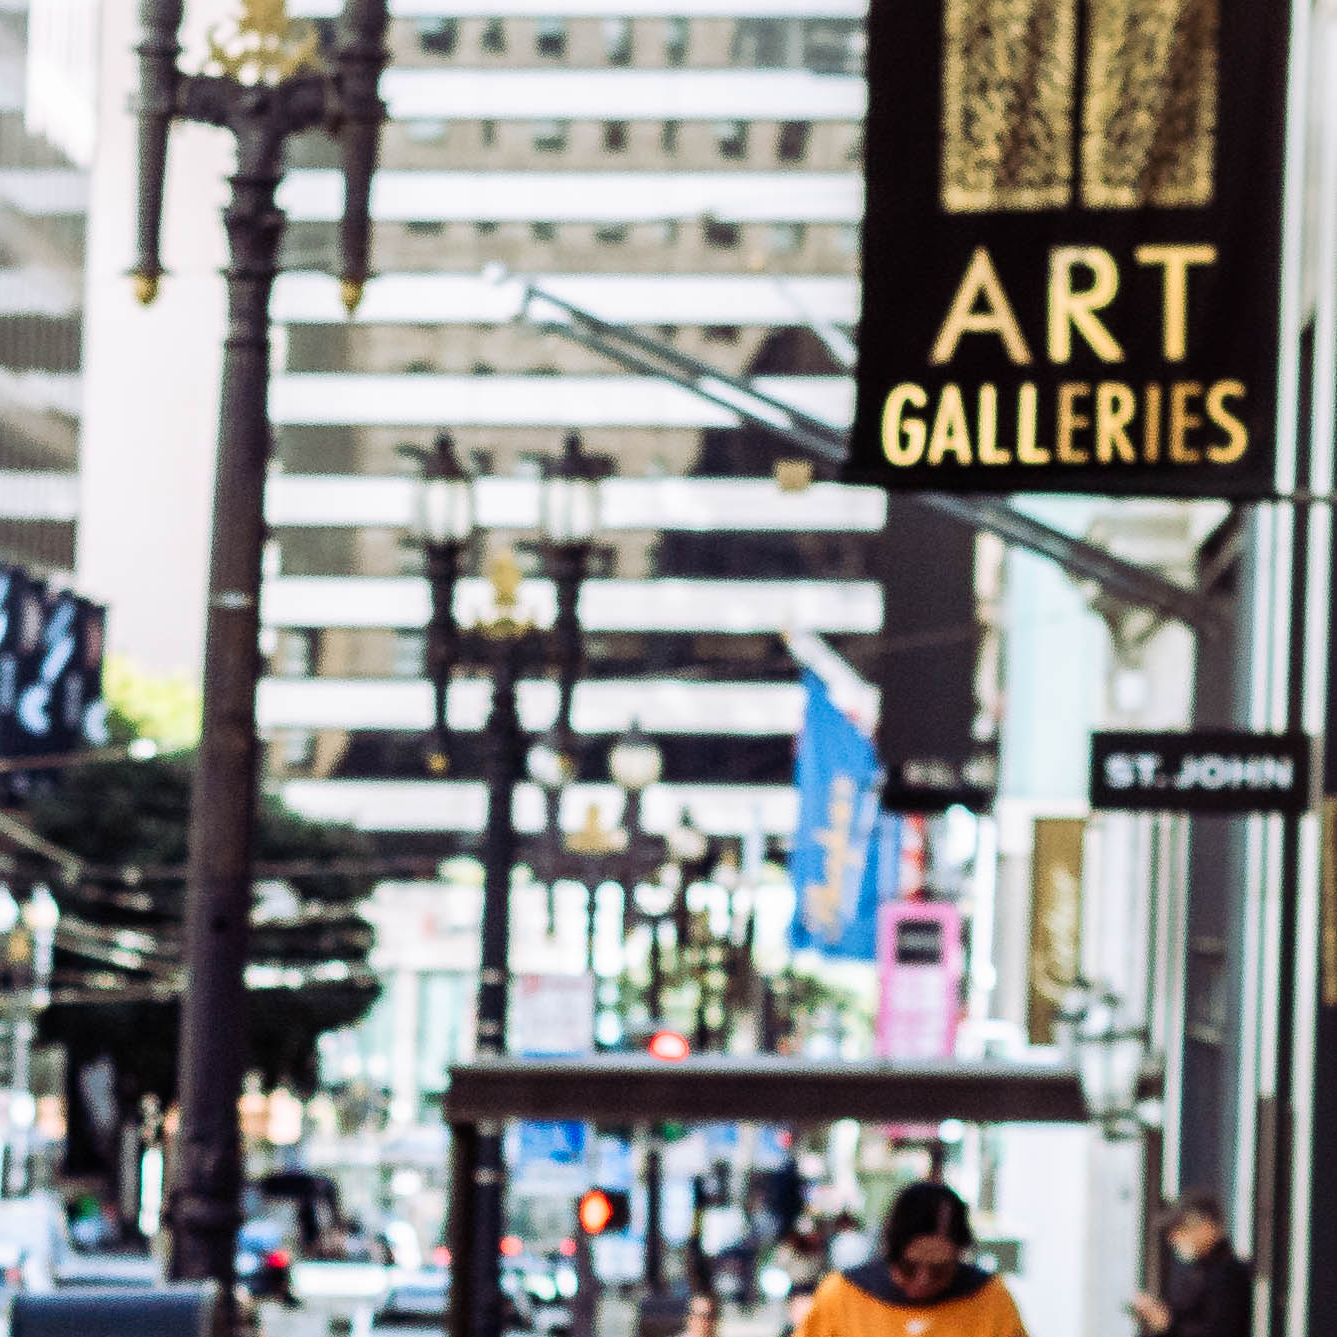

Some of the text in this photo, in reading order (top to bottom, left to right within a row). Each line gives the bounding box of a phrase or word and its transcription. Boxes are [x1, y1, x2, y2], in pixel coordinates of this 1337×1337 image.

[930, 244, 1218, 366] ART
[881, 379, 1249, 467] GALLERIES
[1175, 752, 1295, 790] JOHN
